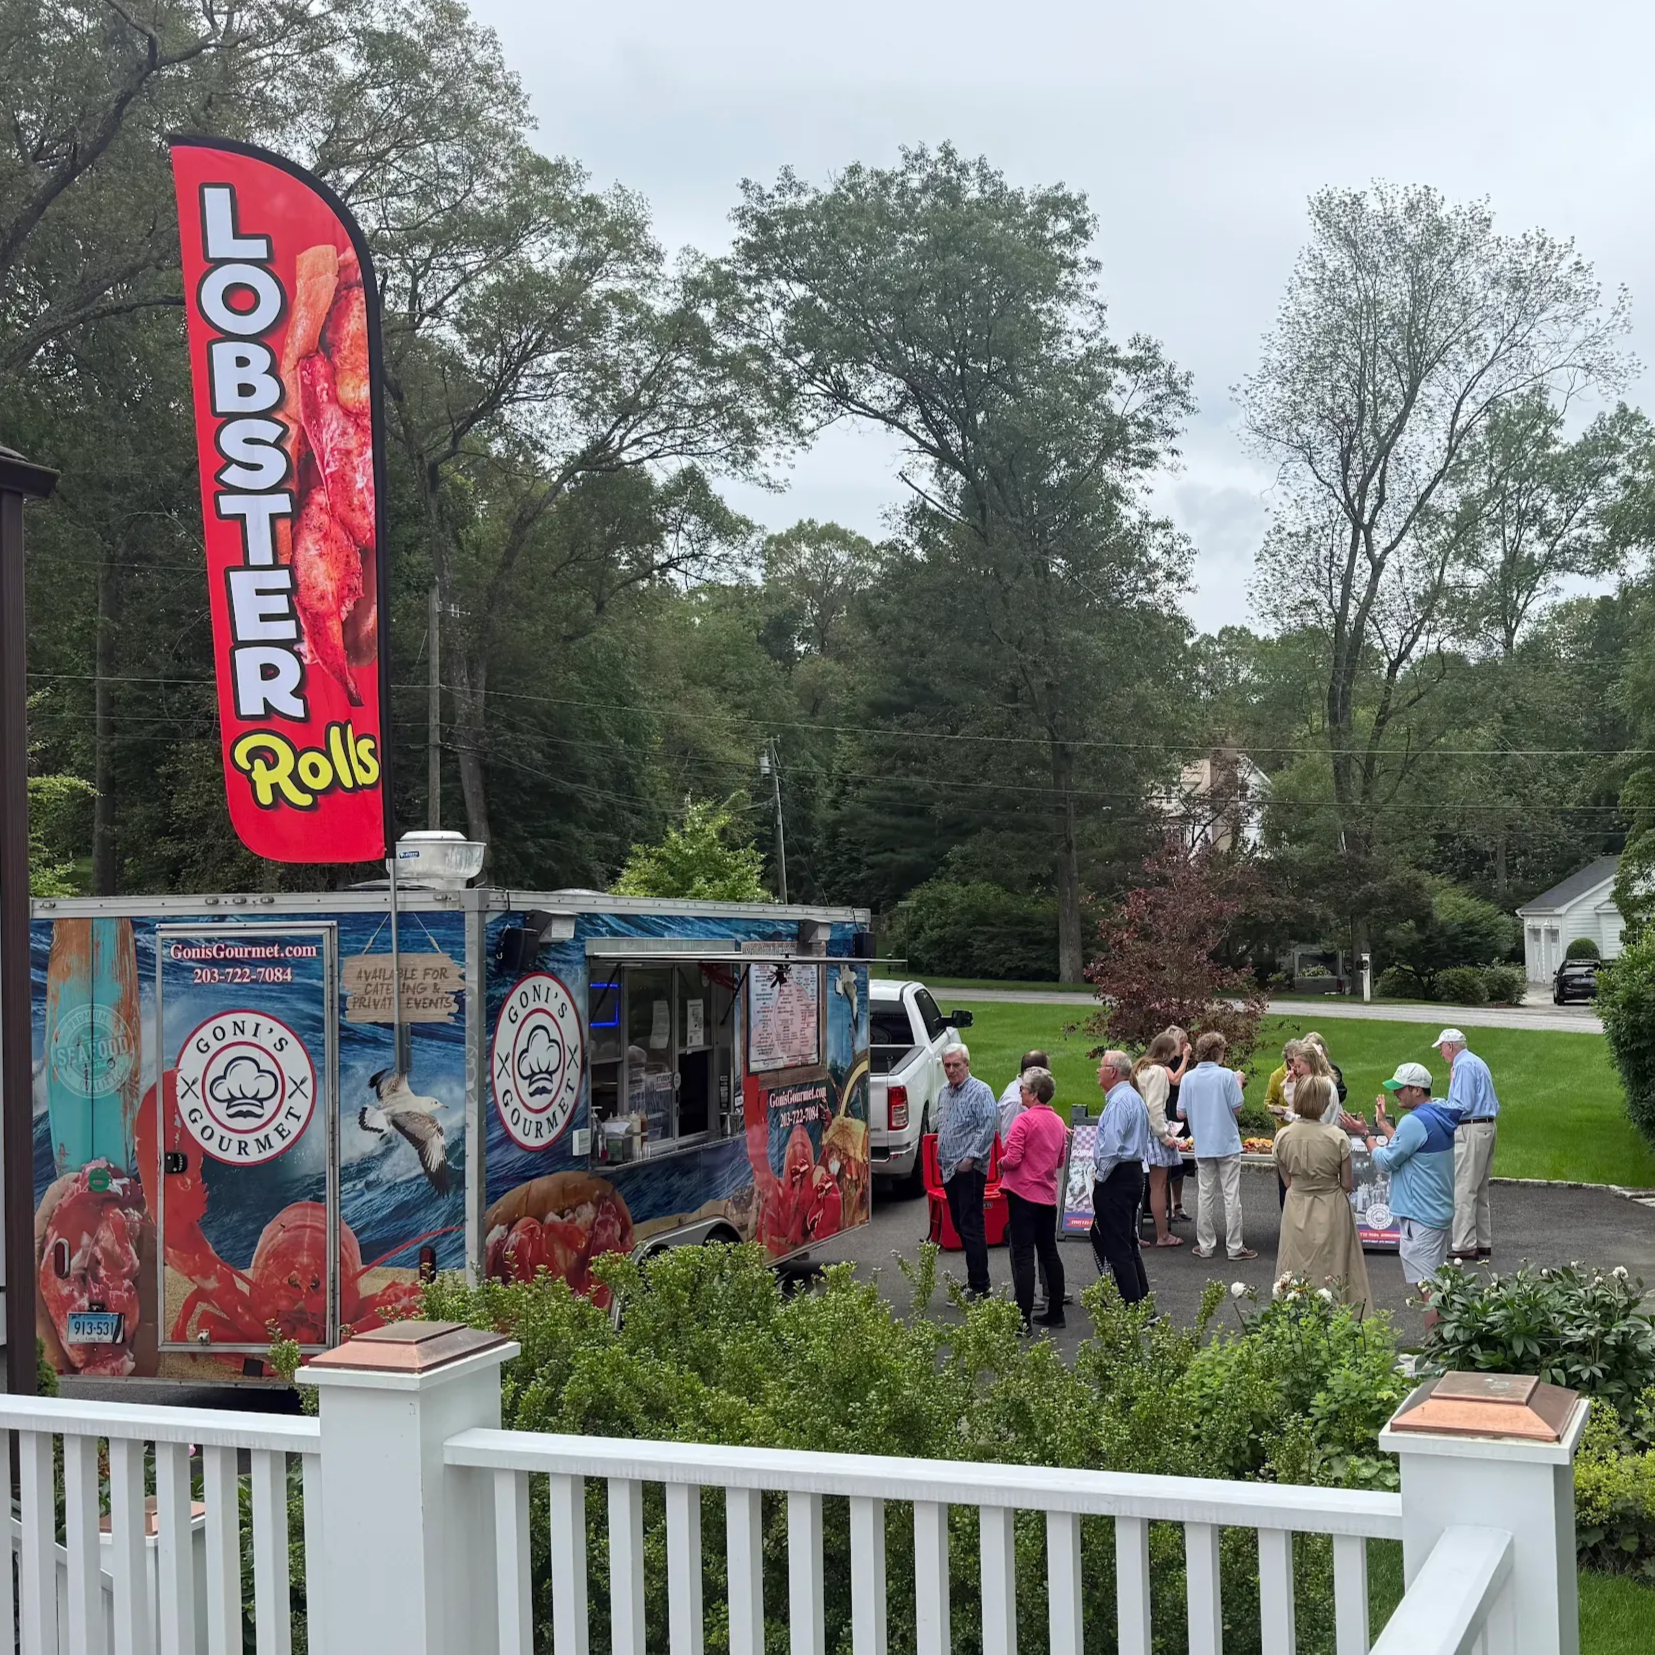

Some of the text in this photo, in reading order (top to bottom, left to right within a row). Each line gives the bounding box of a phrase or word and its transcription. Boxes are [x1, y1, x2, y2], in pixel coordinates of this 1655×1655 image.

[198, 185, 308, 720] LOBSTER
[232, 722, 381, 807] Rolls
[170, 942, 318, 959] GonisGourmet.com
[193, 967, 293, 984] 203-722-7084
[364, 982, 441, 995] CATEING &
[423, 967, 450, 981] FOR
[352, 996, 453, 1010] PRIVAT EVENTS
[508, 984, 568, 1025] GONI'S
[196, 1020, 289, 1054] GONI'S
[502, 1078, 576, 1139] GOURMET
[188, 1106, 302, 1156] GOURMET
